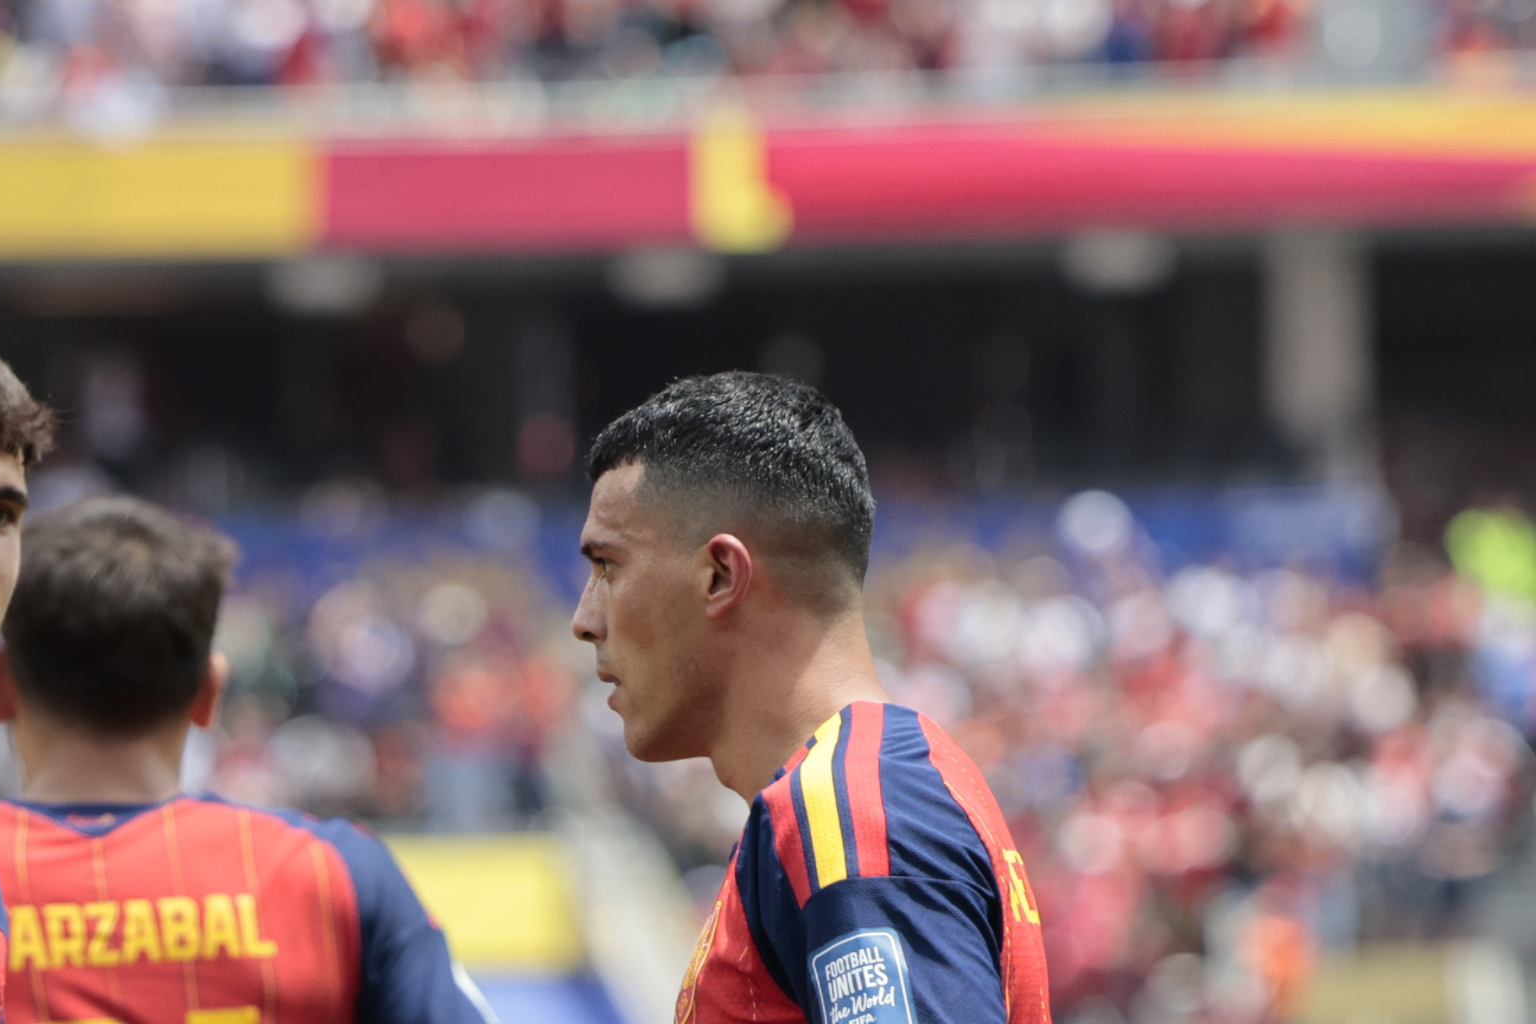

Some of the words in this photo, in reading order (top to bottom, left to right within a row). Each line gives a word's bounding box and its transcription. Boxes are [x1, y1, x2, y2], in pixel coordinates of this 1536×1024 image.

[825, 946, 884, 981] FOOTBALL
[828, 963, 889, 1003] UNITES
[830, 1003, 850, 1024] the
[851, 986, 895, 1015] World
